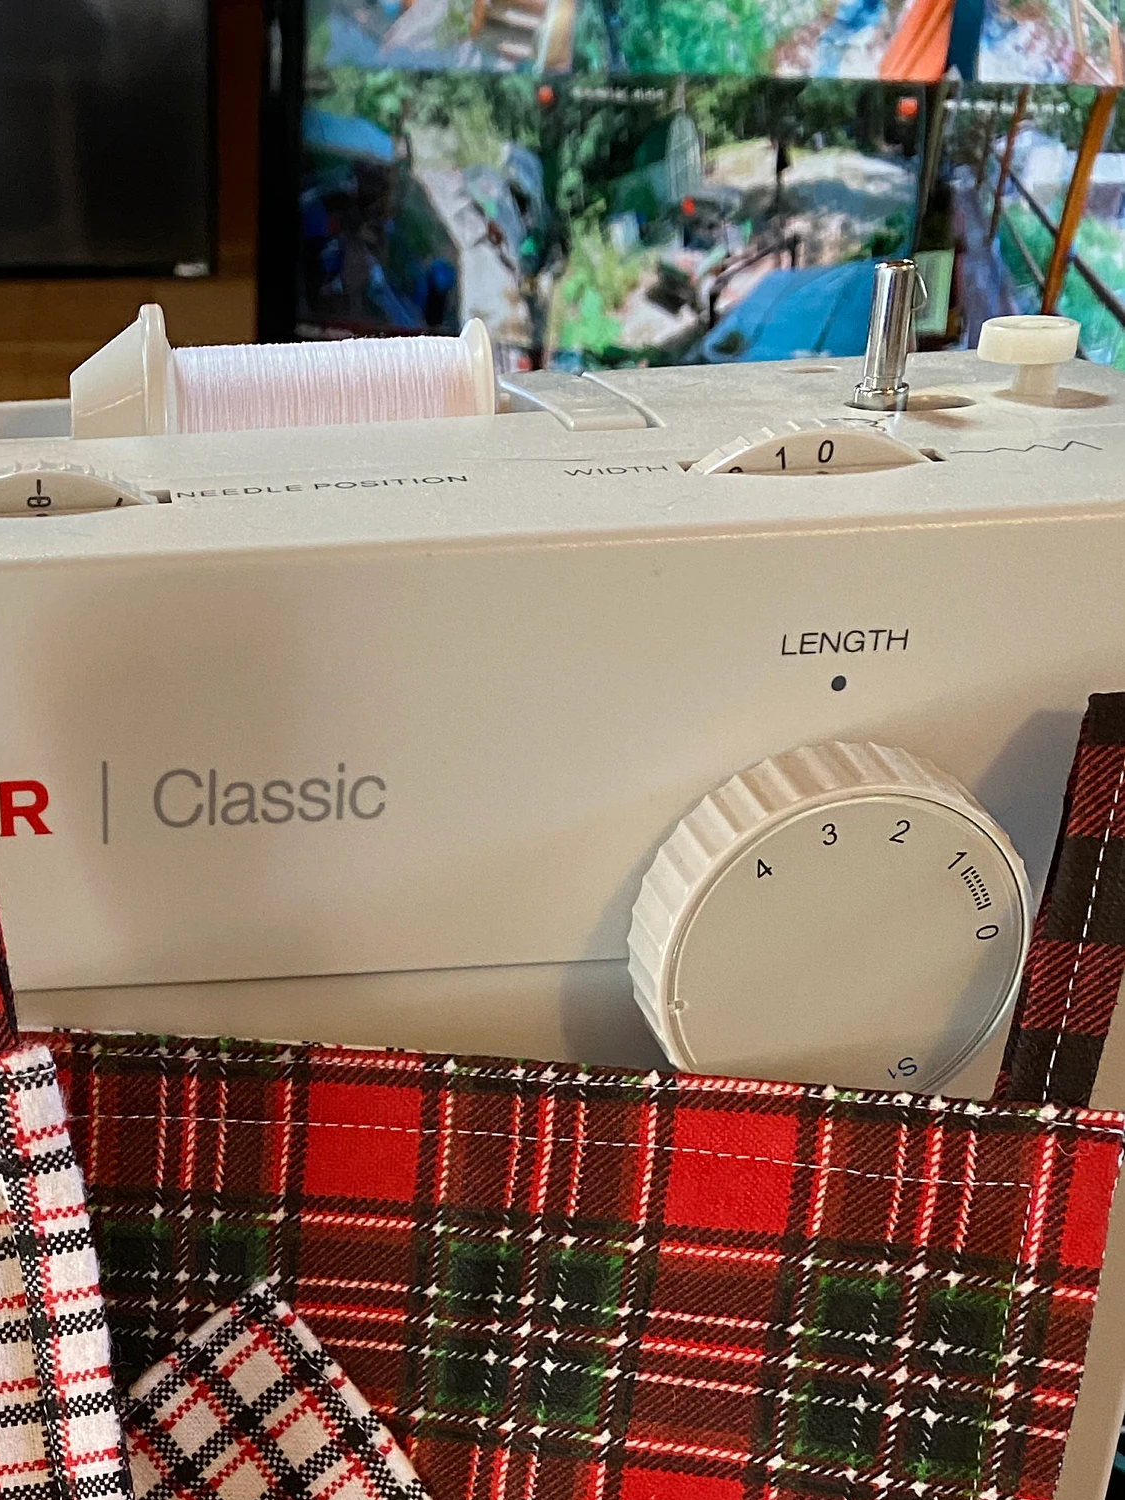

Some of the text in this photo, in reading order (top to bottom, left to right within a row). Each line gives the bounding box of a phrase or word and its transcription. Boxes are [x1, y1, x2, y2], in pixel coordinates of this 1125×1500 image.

[776, 439, 834, 470] 1 0
[564, 464, 669, 477] WIDTH
[176, 474, 469, 499] NEEDLE POSITION
[781, 628, 909, 656] LENGTH
[153, 762, 387, 828] Classic
[821, 823, 838, 846] 3
[888, 819, 911, 844] 2
[756, 858, 773, 879] 4
[947, 851, 968, 870] 1
[975, 924, 999, 940] 0
